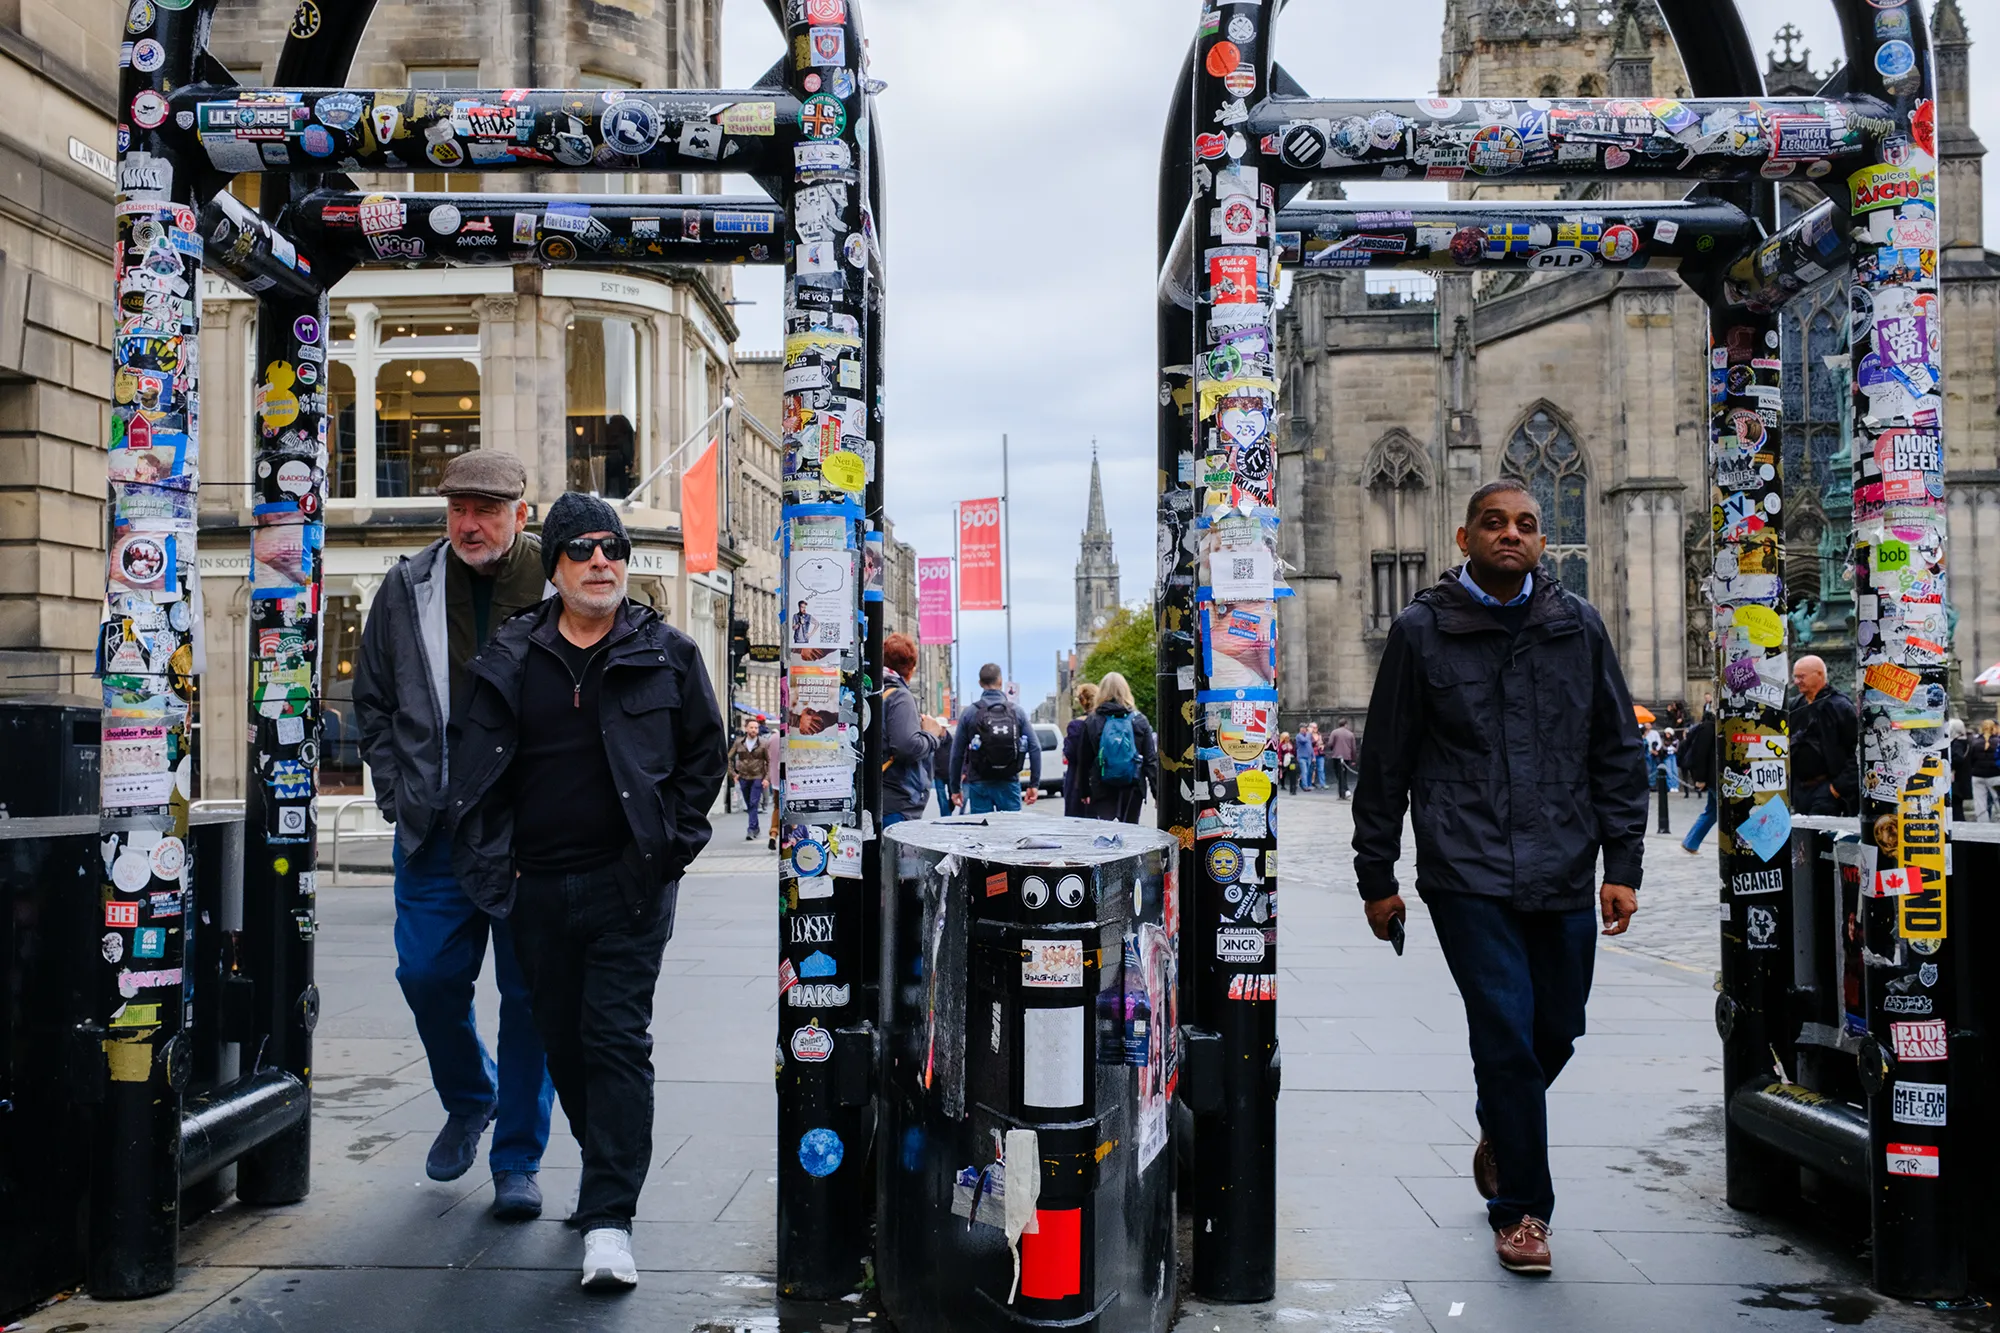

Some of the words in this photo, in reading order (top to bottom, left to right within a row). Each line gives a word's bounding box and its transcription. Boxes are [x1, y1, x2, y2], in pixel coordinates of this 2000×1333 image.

[1798, 128, 1827, 139] INTER
[1781, 138, 1829, 150] REGIONAL
[75, 141, 117, 178] LAWNMA
[1871, 170, 1910, 184] Dulces
[125, 202, 180, 215] Kaiserslauter
[360, 202, 399, 219] RUDE
[362, 215, 401, 232] FANS
[715, 221, 770, 231] CANETTES
[1538, 254, 1584, 268] PLP
[601, 282, 620, 293] EST
[622, 285, 640, 296] 1989
[811, 293, 830, 302] VOID
[1881, 317, 1917, 341] NUR
[1889, 332, 1919, 351] DER
[1894, 435, 1939, 454] MORE
[1246, 449, 1265, 471] 77
[1894, 453, 1939, 471] BEER
[961, 508, 998, 530] 900
[200, 559, 212, 568] IN
[215, 558, 250, 568] SCOTT
[630, 555, 663, 569] ANE
[1879, 552, 1907, 563] bob
[920, 565, 949, 581] 900
[105, 728, 137, 738] Shoulder
[139, 727, 163, 736] Pads
[1756, 765, 1784, 789] DROP
[1732, 871, 1782, 893] SCANER
[1234, 883, 1258, 920] CONTRAST
[1224, 927, 1259, 935] GRAFFITI
[1899, 1025, 1947, 1042] RUDE
[1899, 1041, 1947, 1057] FANS
[1895, 1088, 1945, 1103] MELON
[1894, 1100, 1916, 1117] BFL
[1923, 1102, 1945, 1118] EXP
